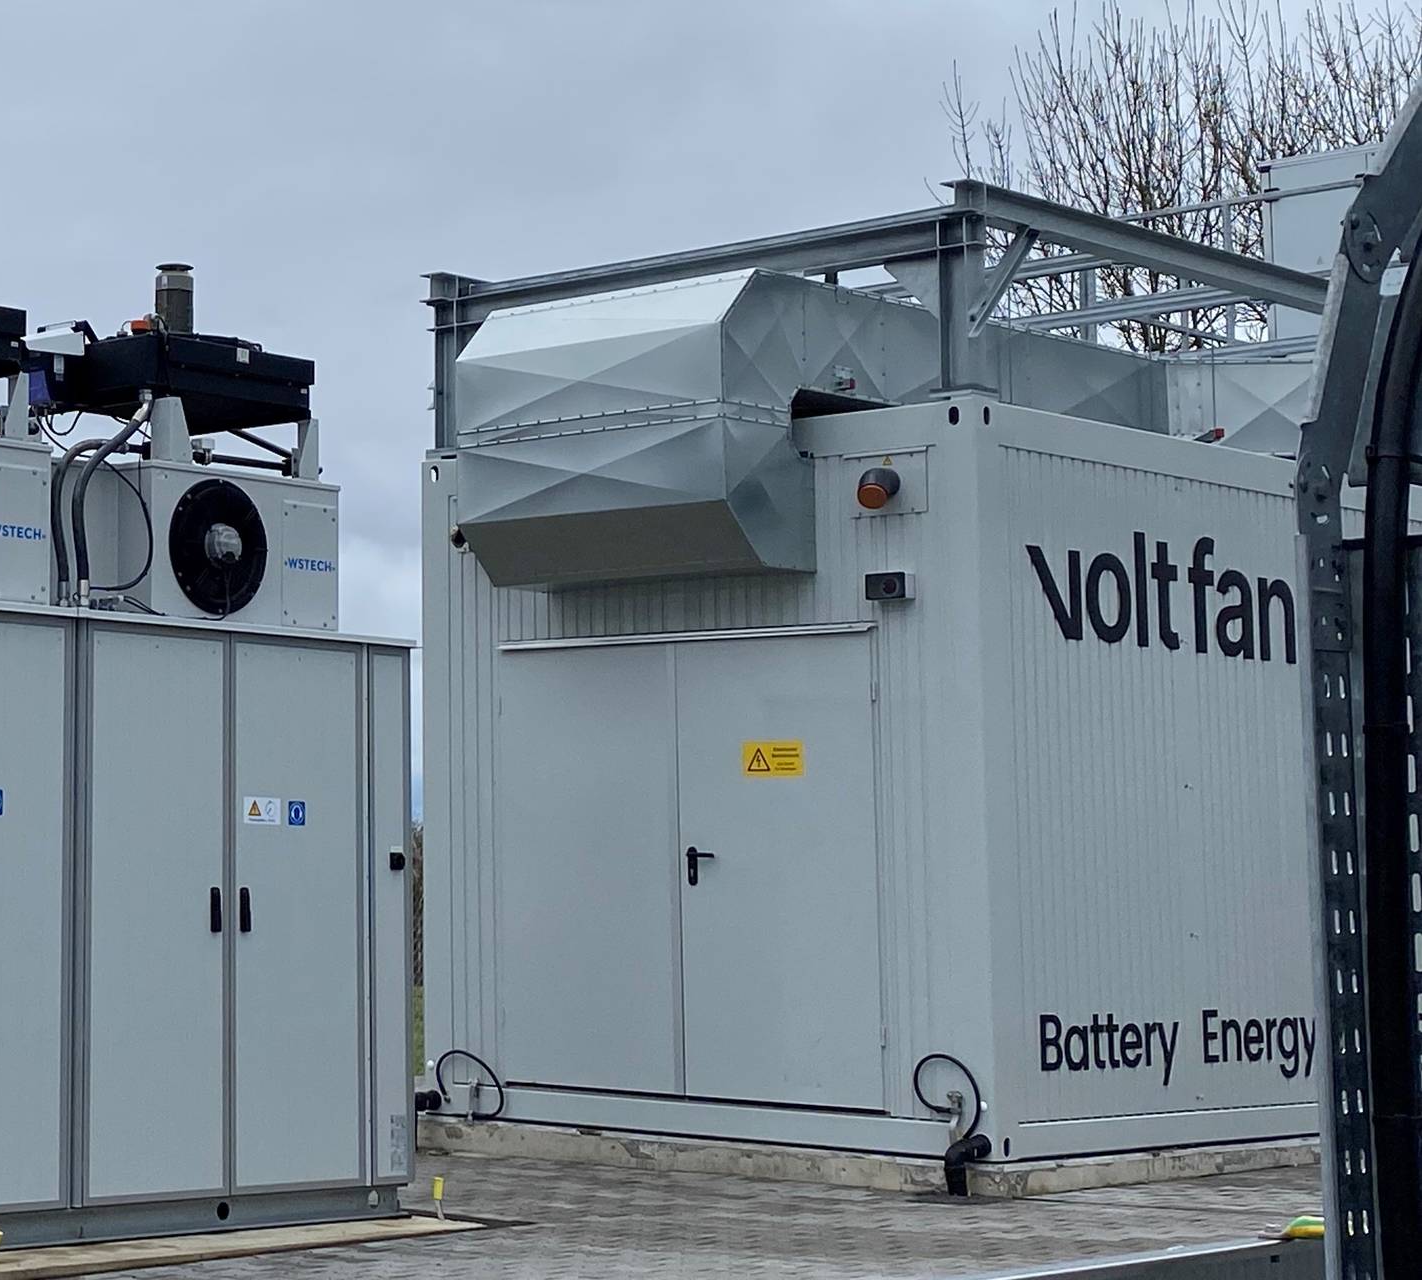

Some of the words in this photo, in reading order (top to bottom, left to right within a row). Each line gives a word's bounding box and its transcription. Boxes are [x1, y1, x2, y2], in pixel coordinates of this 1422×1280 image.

[287, 557, 332, 572] WSTECH
[1039, 1013, 1179, 1086] Battery
[1202, 1009, 1316, 1079] Energy
